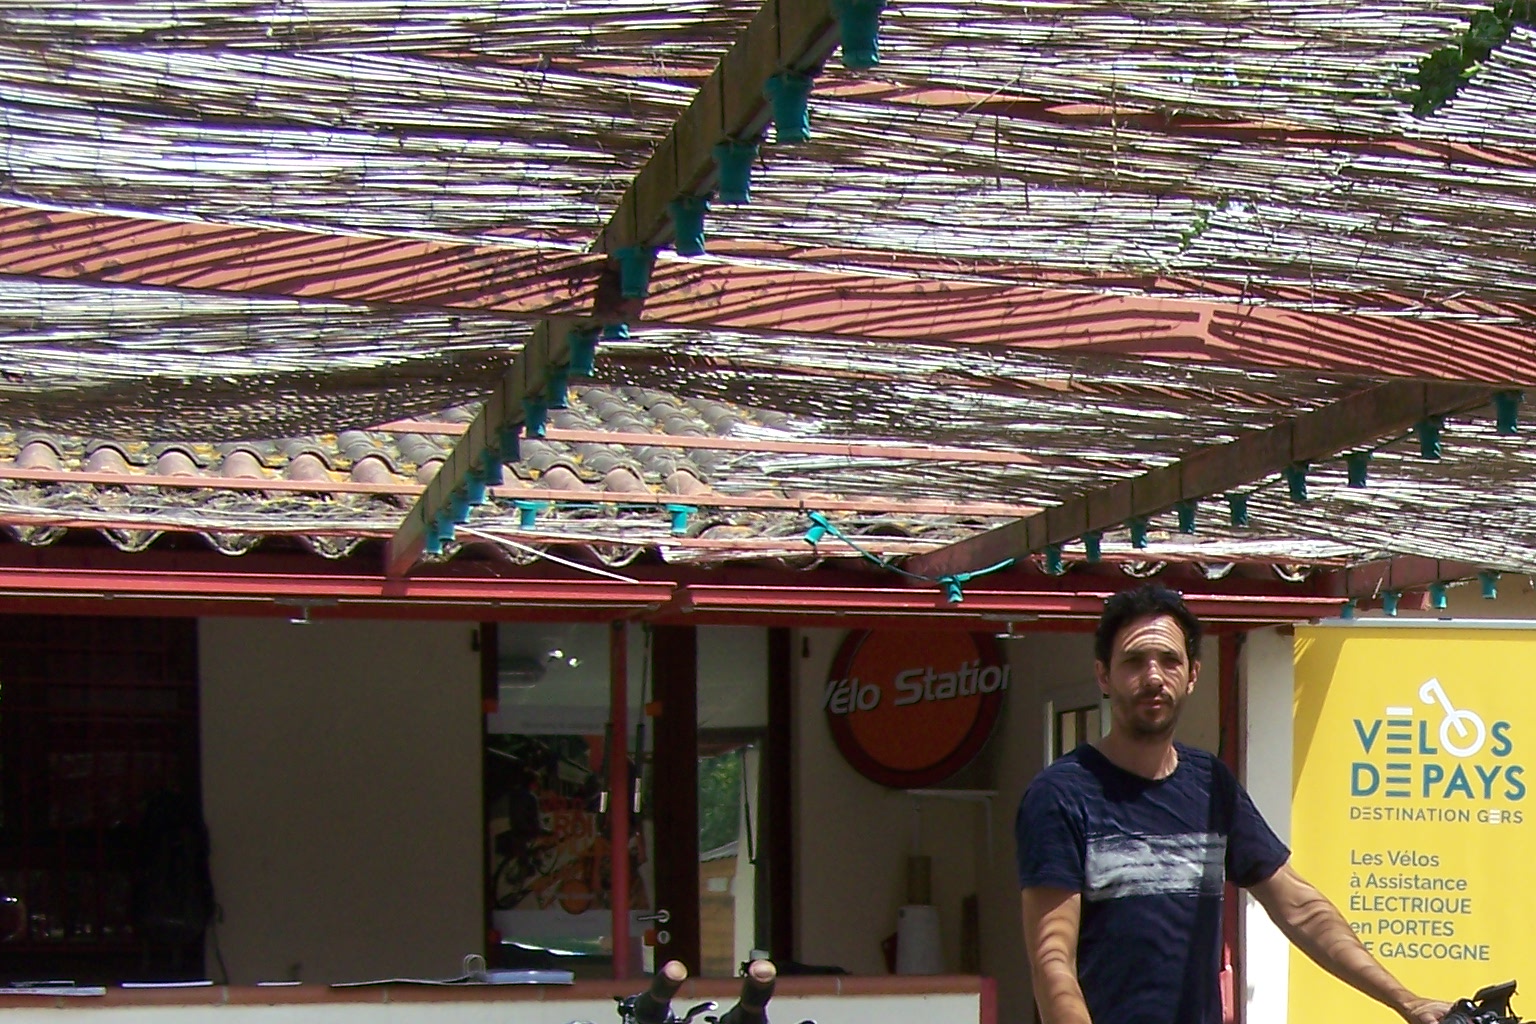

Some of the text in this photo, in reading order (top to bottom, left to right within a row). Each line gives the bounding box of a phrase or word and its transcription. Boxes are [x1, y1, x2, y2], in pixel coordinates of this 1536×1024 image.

[1423, 763, 1527, 801] PAYS
[1350, 806, 1524, 825] DESTINATION GERS
[1351, 850, 1440, 867] Les Vélos
[1350, 872, 1468, 891] à Assistance
[1350, 892, 1472, 915] ÉLECTRIQUE
[1350, 919, 1455, 937] en PORTES
[1379, 942, 1491, 961] GASCOGNE
